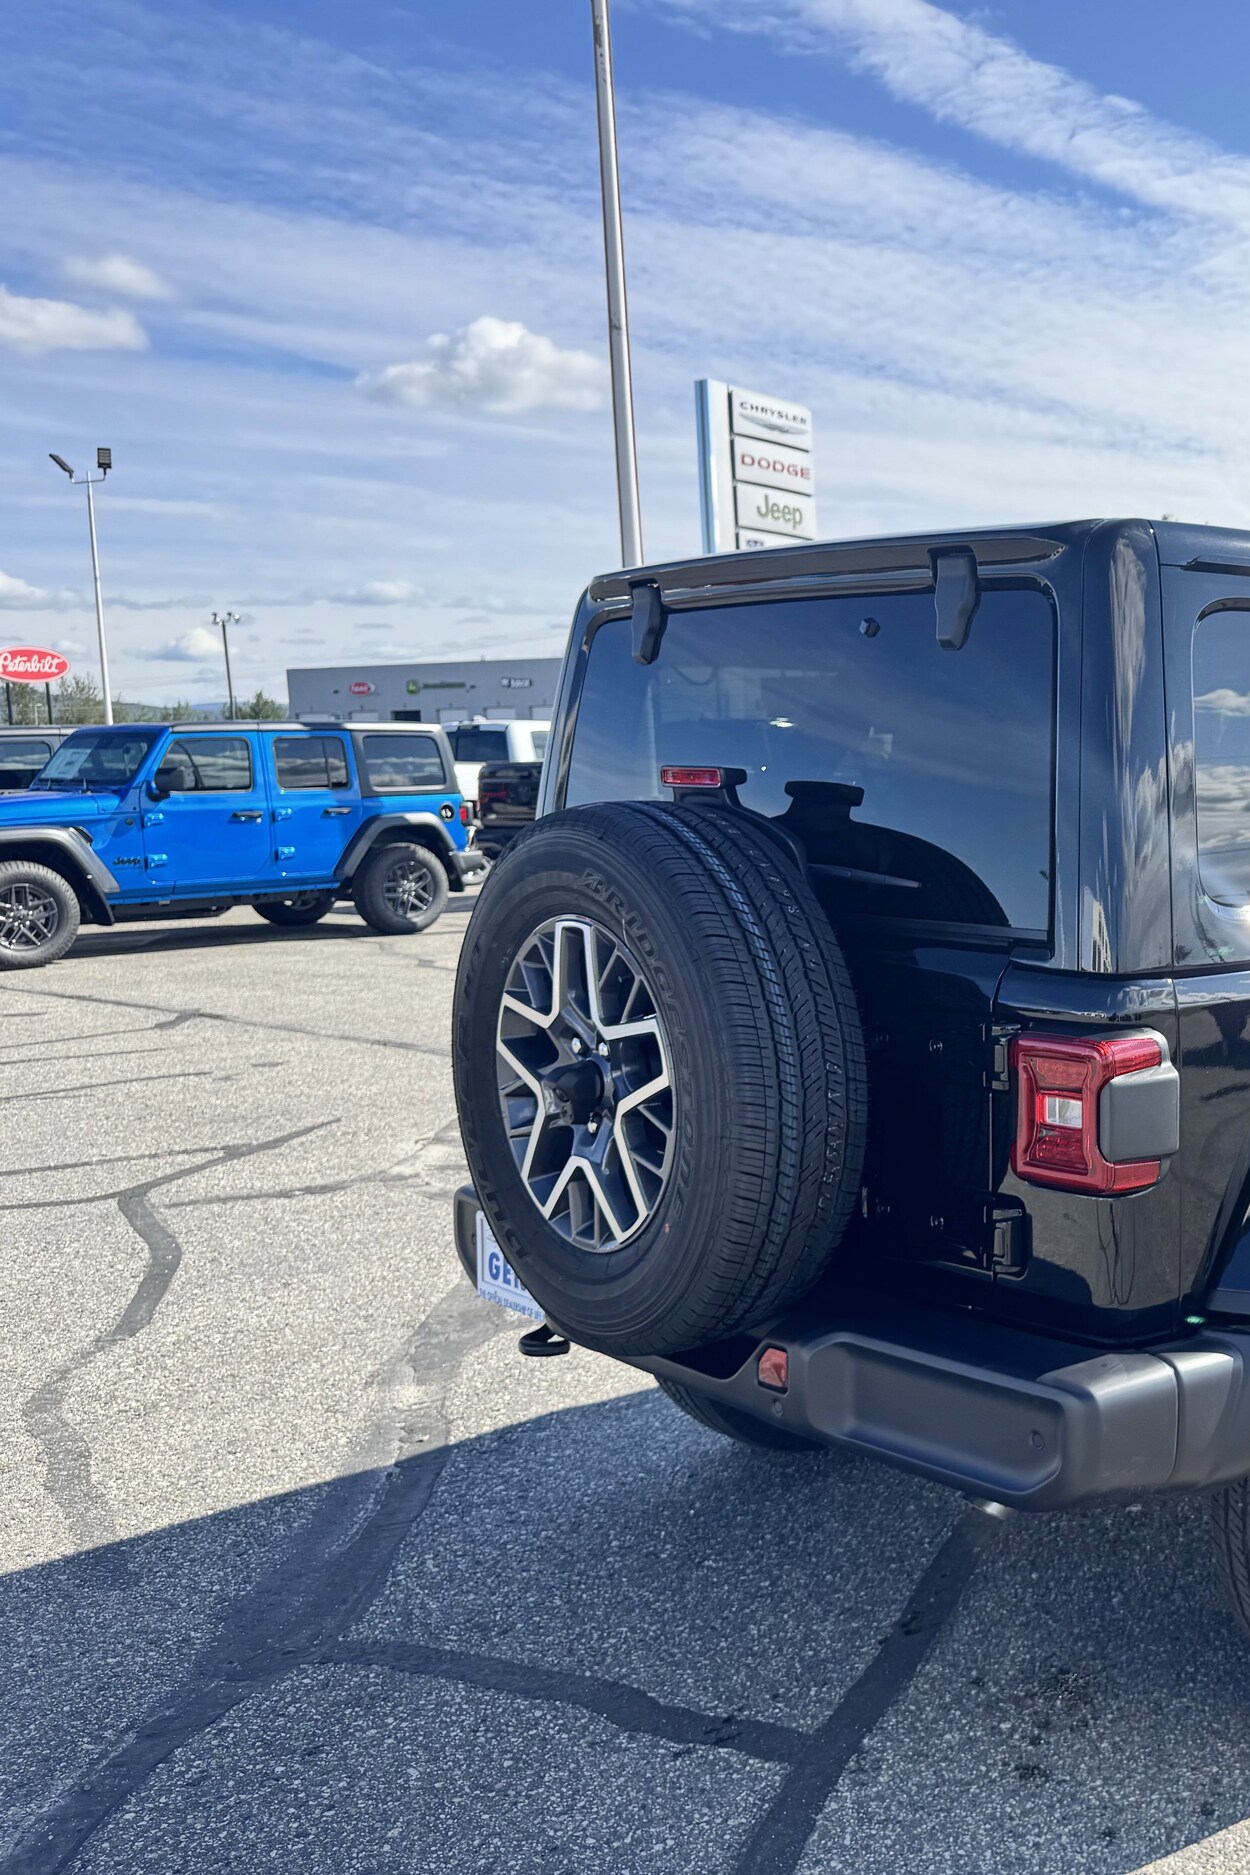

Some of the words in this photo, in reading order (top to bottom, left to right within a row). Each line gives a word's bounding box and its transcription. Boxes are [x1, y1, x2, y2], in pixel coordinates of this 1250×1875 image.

[740, 401, 807, 426] CHRYSLER
[741, 453, 811, 481] DODGE
[756, 493, 803, 529] Jeep
[0, 652, 64, 674] Peterbilt
[112, 856, 141, 867] Jeep
